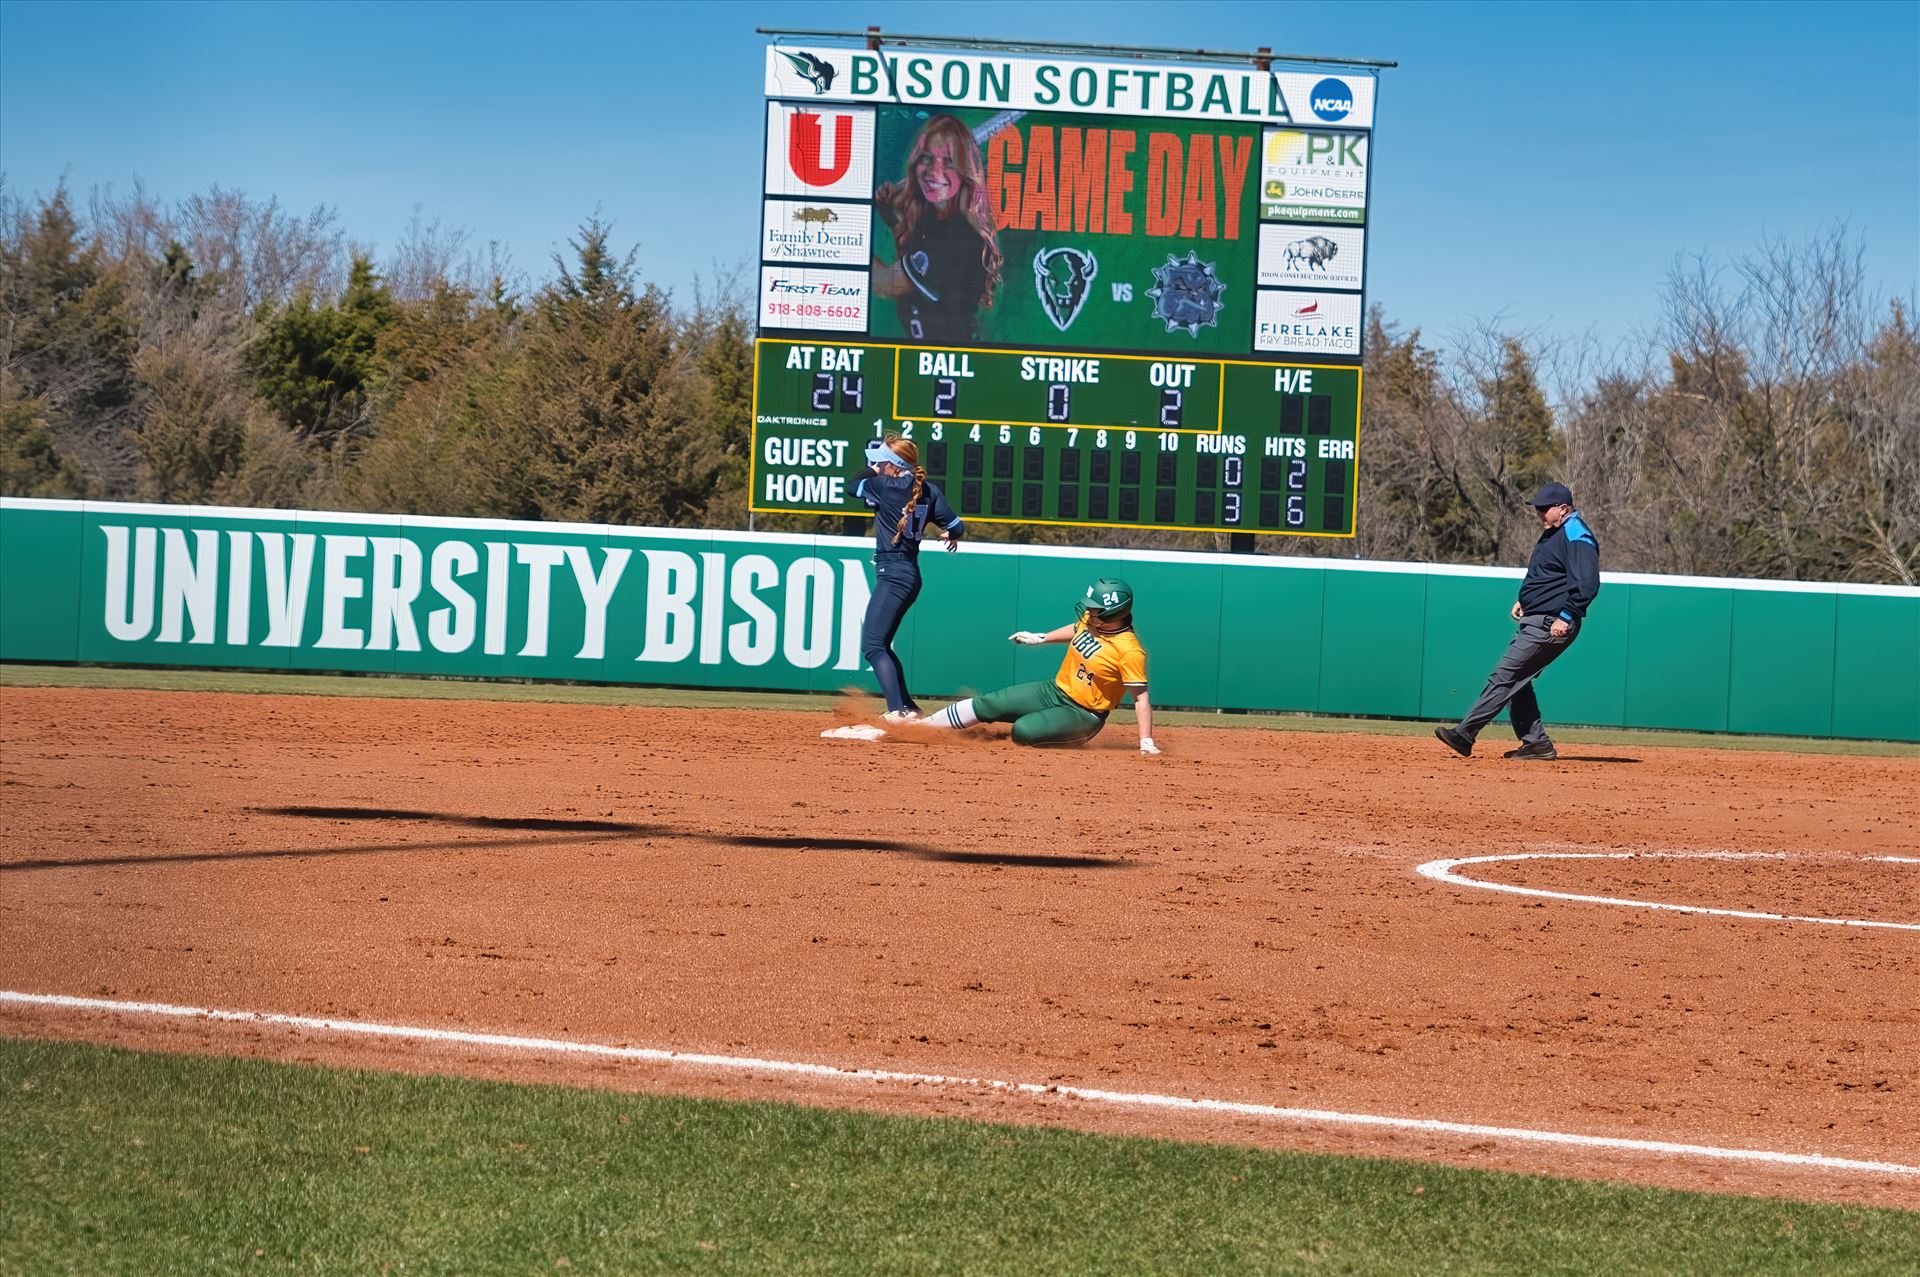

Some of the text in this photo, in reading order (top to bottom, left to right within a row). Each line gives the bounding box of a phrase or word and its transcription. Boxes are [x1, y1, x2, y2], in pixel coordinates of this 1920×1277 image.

[850, 55, 1290, 117] BISON SOFTBALL
[1313, 98, 1352, 112] NCAA
[987, 124, 1253, 241] GAME DAY
[1267, 166, 1364, 178] EQUIPMENT
[1289, 186, 1364, 200] JOHN DEERE
[1267, 205, 1360, 219] pkequipment.com
[768, 229, 864, 247] Family Dental
[770, 243, 841, 259] of Shawnee
[1111, 282, 1133, 302] VS
[768, 303, 860, 319] 918-808-6602
[1259, 335, 1353, 349] FRY BREAD TACO
[1260, 323, 1354, 338] FIRELAKE
[786, 346, 864, 372] AT BAT
[918, 352, 974, 378] BALL
[1020, 357, 1100, 384] STRIKE
[1149, 363, 1196, 388] OUT
[1274, 368, 1313, 393] H/E
[812, 372, 863, 411] 24
[934, 378, 956, 415] 2
[1048, 384, 1069, 421] 0
[1161, 389, 1182, 425] 2
[756, 415, 828, 426] DAKTRONICS
[764, 437, 849, 467] GUEST
[873, 418, 1354, 460] 1 2 3 4 5 6 7 8 9 10 RUNS HITS ERR
[1224, 457, 1306, 489] 0 2
[765, 473, 845, 504] HOME
[1224, 492, 1304, 525] 3 6
[98, 525, 633, 660] UNIVERSITY
[1102, 591, 1120, 606] 24
